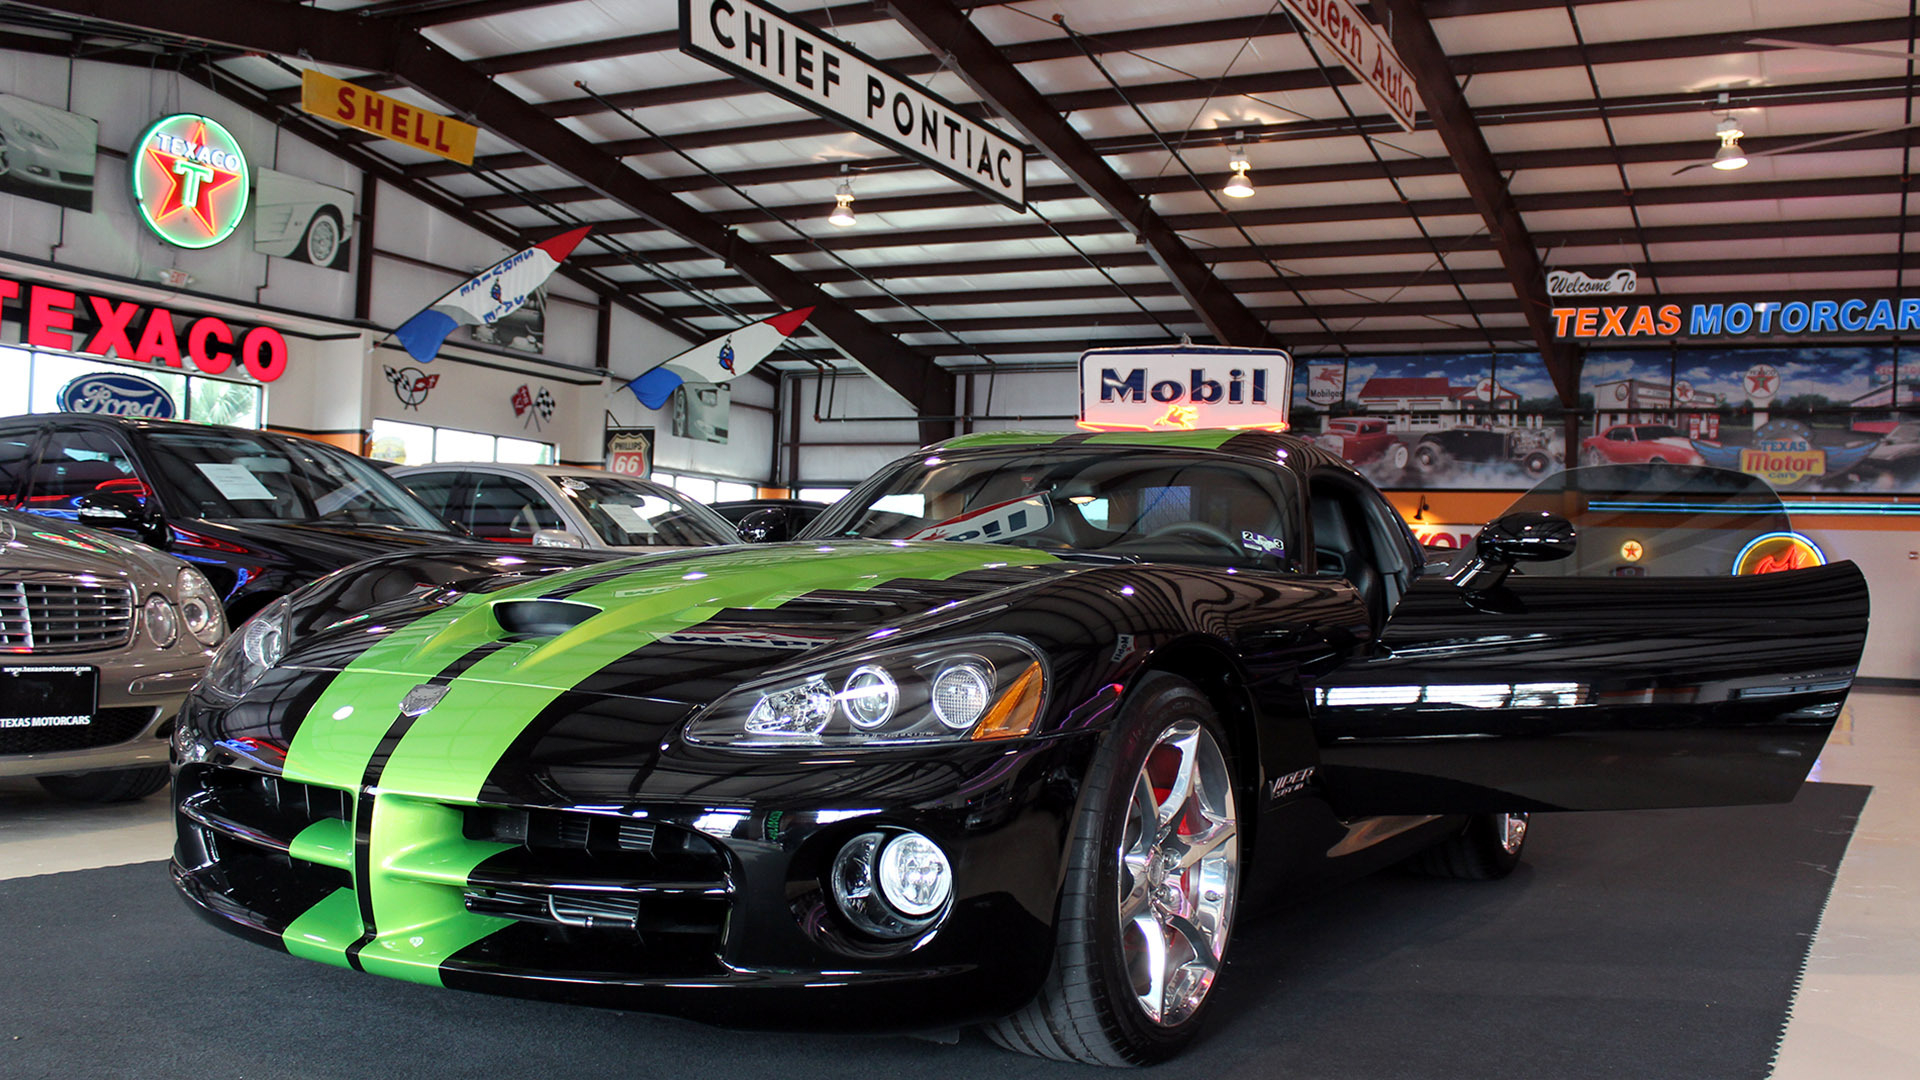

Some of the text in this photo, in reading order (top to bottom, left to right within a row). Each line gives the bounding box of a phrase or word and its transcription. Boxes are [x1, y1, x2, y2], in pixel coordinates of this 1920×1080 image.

[709, 0, 1012, 189] CHIEF PONTIAC
[1372, 43, 1413, 118] Auto
[337, 86, 450, 153] SHELL
[156, 132, 241, 171] TEXACO
[1550, 272, 1635, 294] Welcome To
[1552, 304, 1682, 338] TEXAS
[73, 381, 162, 418] Ford
[1100, 368, 1268, 405] Mobil
[615, 455, 641, 473] 66
[1746, 452, 1819, 472] Motor
[1760, 441, 1807, 452] TEXAS
[0, 715, 91, 729] TEXAS MOTORCARS
